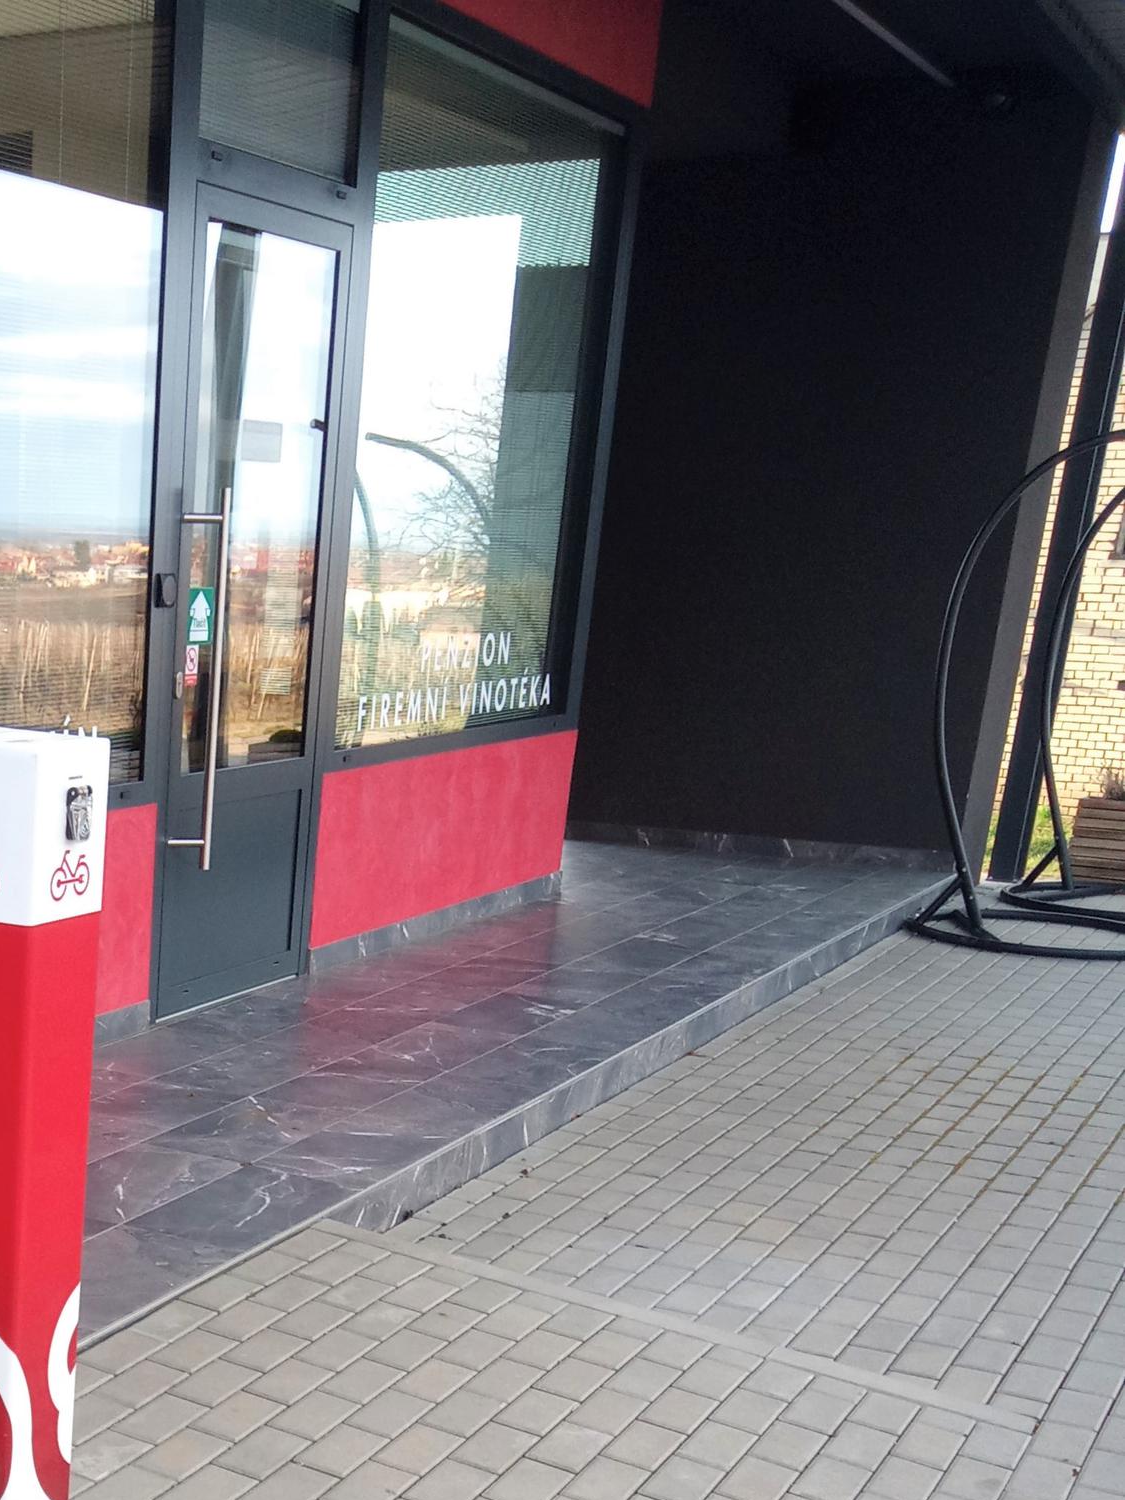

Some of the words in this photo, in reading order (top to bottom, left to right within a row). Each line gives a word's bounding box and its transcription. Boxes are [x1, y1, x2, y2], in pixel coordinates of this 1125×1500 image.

[420, 631, 511, 673] PENZION
[357, 677, 449, 732] FIREMNÍ
[459, 668, 551, 716] VINOTÉKA
